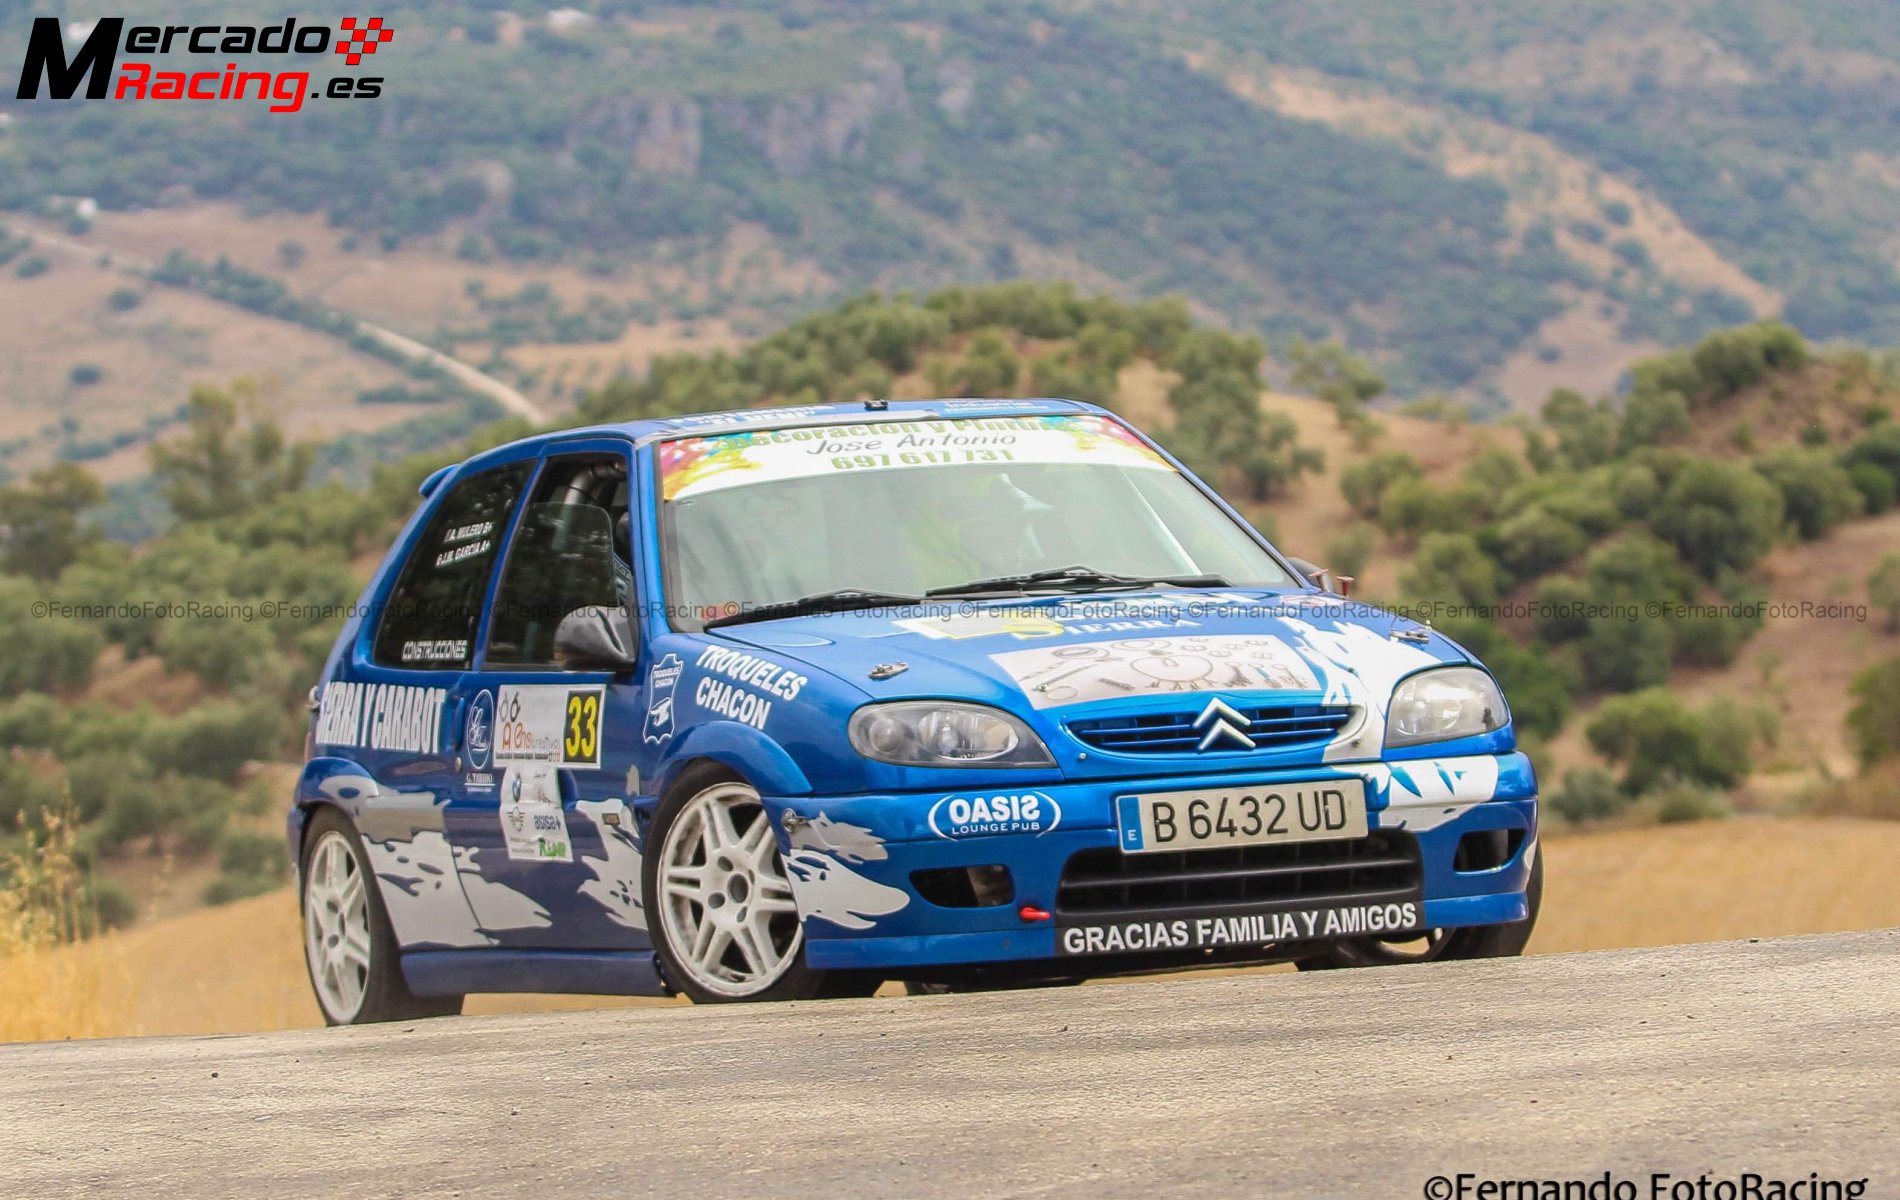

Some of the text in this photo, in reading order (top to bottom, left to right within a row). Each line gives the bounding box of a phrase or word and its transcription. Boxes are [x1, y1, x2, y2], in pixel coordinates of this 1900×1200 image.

[806, 432, 1017, 455] Jose Antonio
[831, 449, 1014, 470] 697 617 731
[402, 640, 468, 662] CONSTRUCCIONES
[695, 644, 808, 701] TROQUELES
[360, 683, 377, 747] Y
[371, 684, 447, 755] CARABOT
[695, 676, 772, 730] CHACON
[566, 695, 598, 757] 33
[949, 795, 1041, 825] OASIS
[952, 821, 1041, 835] LOUNGE PUB
[1152, 789, 1347, 842] B 6432 UD
[1127, 829, 1137, 841] E
[1063, 902, 1417, 953] GRACIAS FAMILIA Y AMIGOS
